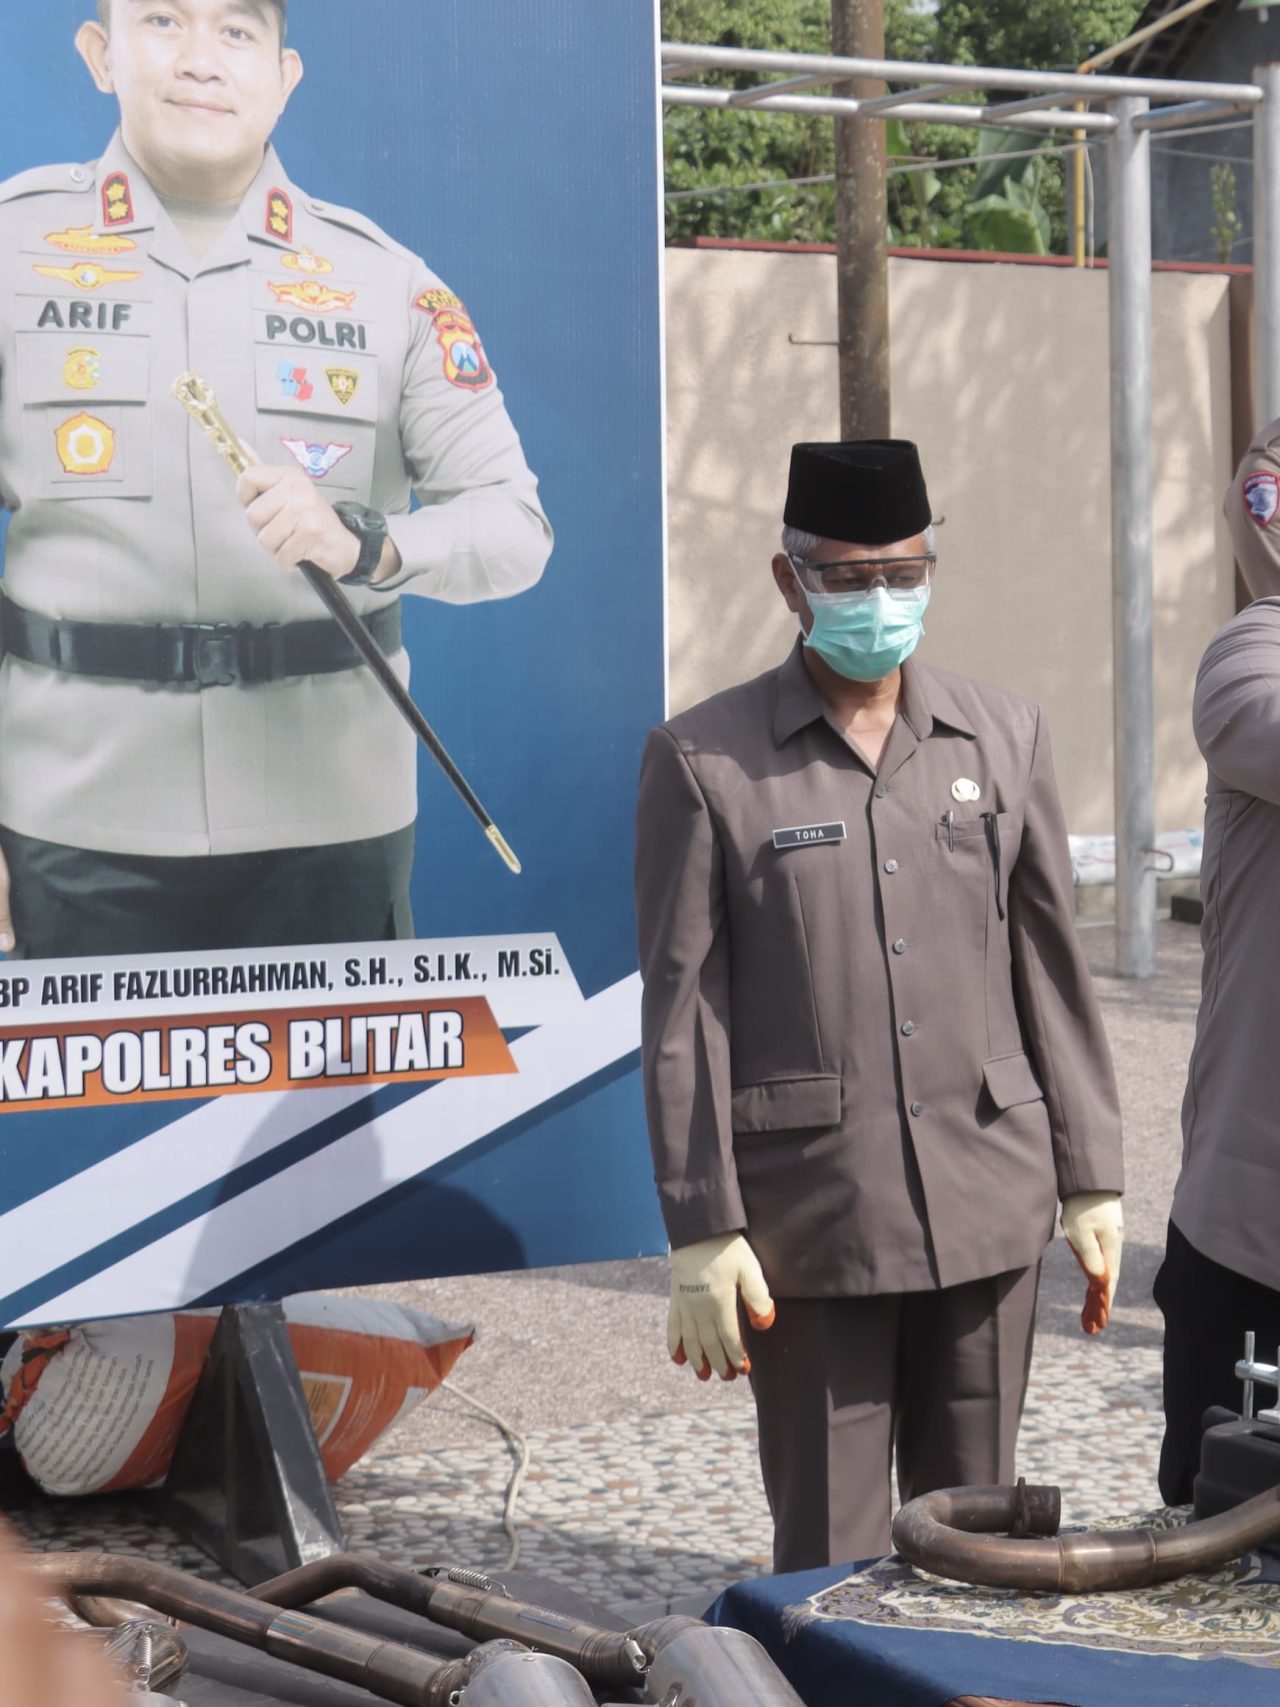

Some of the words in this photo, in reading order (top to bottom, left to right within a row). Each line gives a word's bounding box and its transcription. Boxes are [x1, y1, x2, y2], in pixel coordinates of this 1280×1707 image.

[37, 299, 132, 331] ARIF
[265, 314, 366, 350] POLRI
[795, 828, 825, 841] TOHA
[41, 973, 103, 1006] ARIF
[113, 960, 334, 1001] FAZLURRAHMAN,
[345, 957, 404, 988] S.H.,
[414, 952, 488, 983] S.I.K.,
[498, 948, 560, 978] M.Si.
[0, 1021, 272, 1102] KAPOLRES
[287, 1009, 465, 1081] BLITAR
